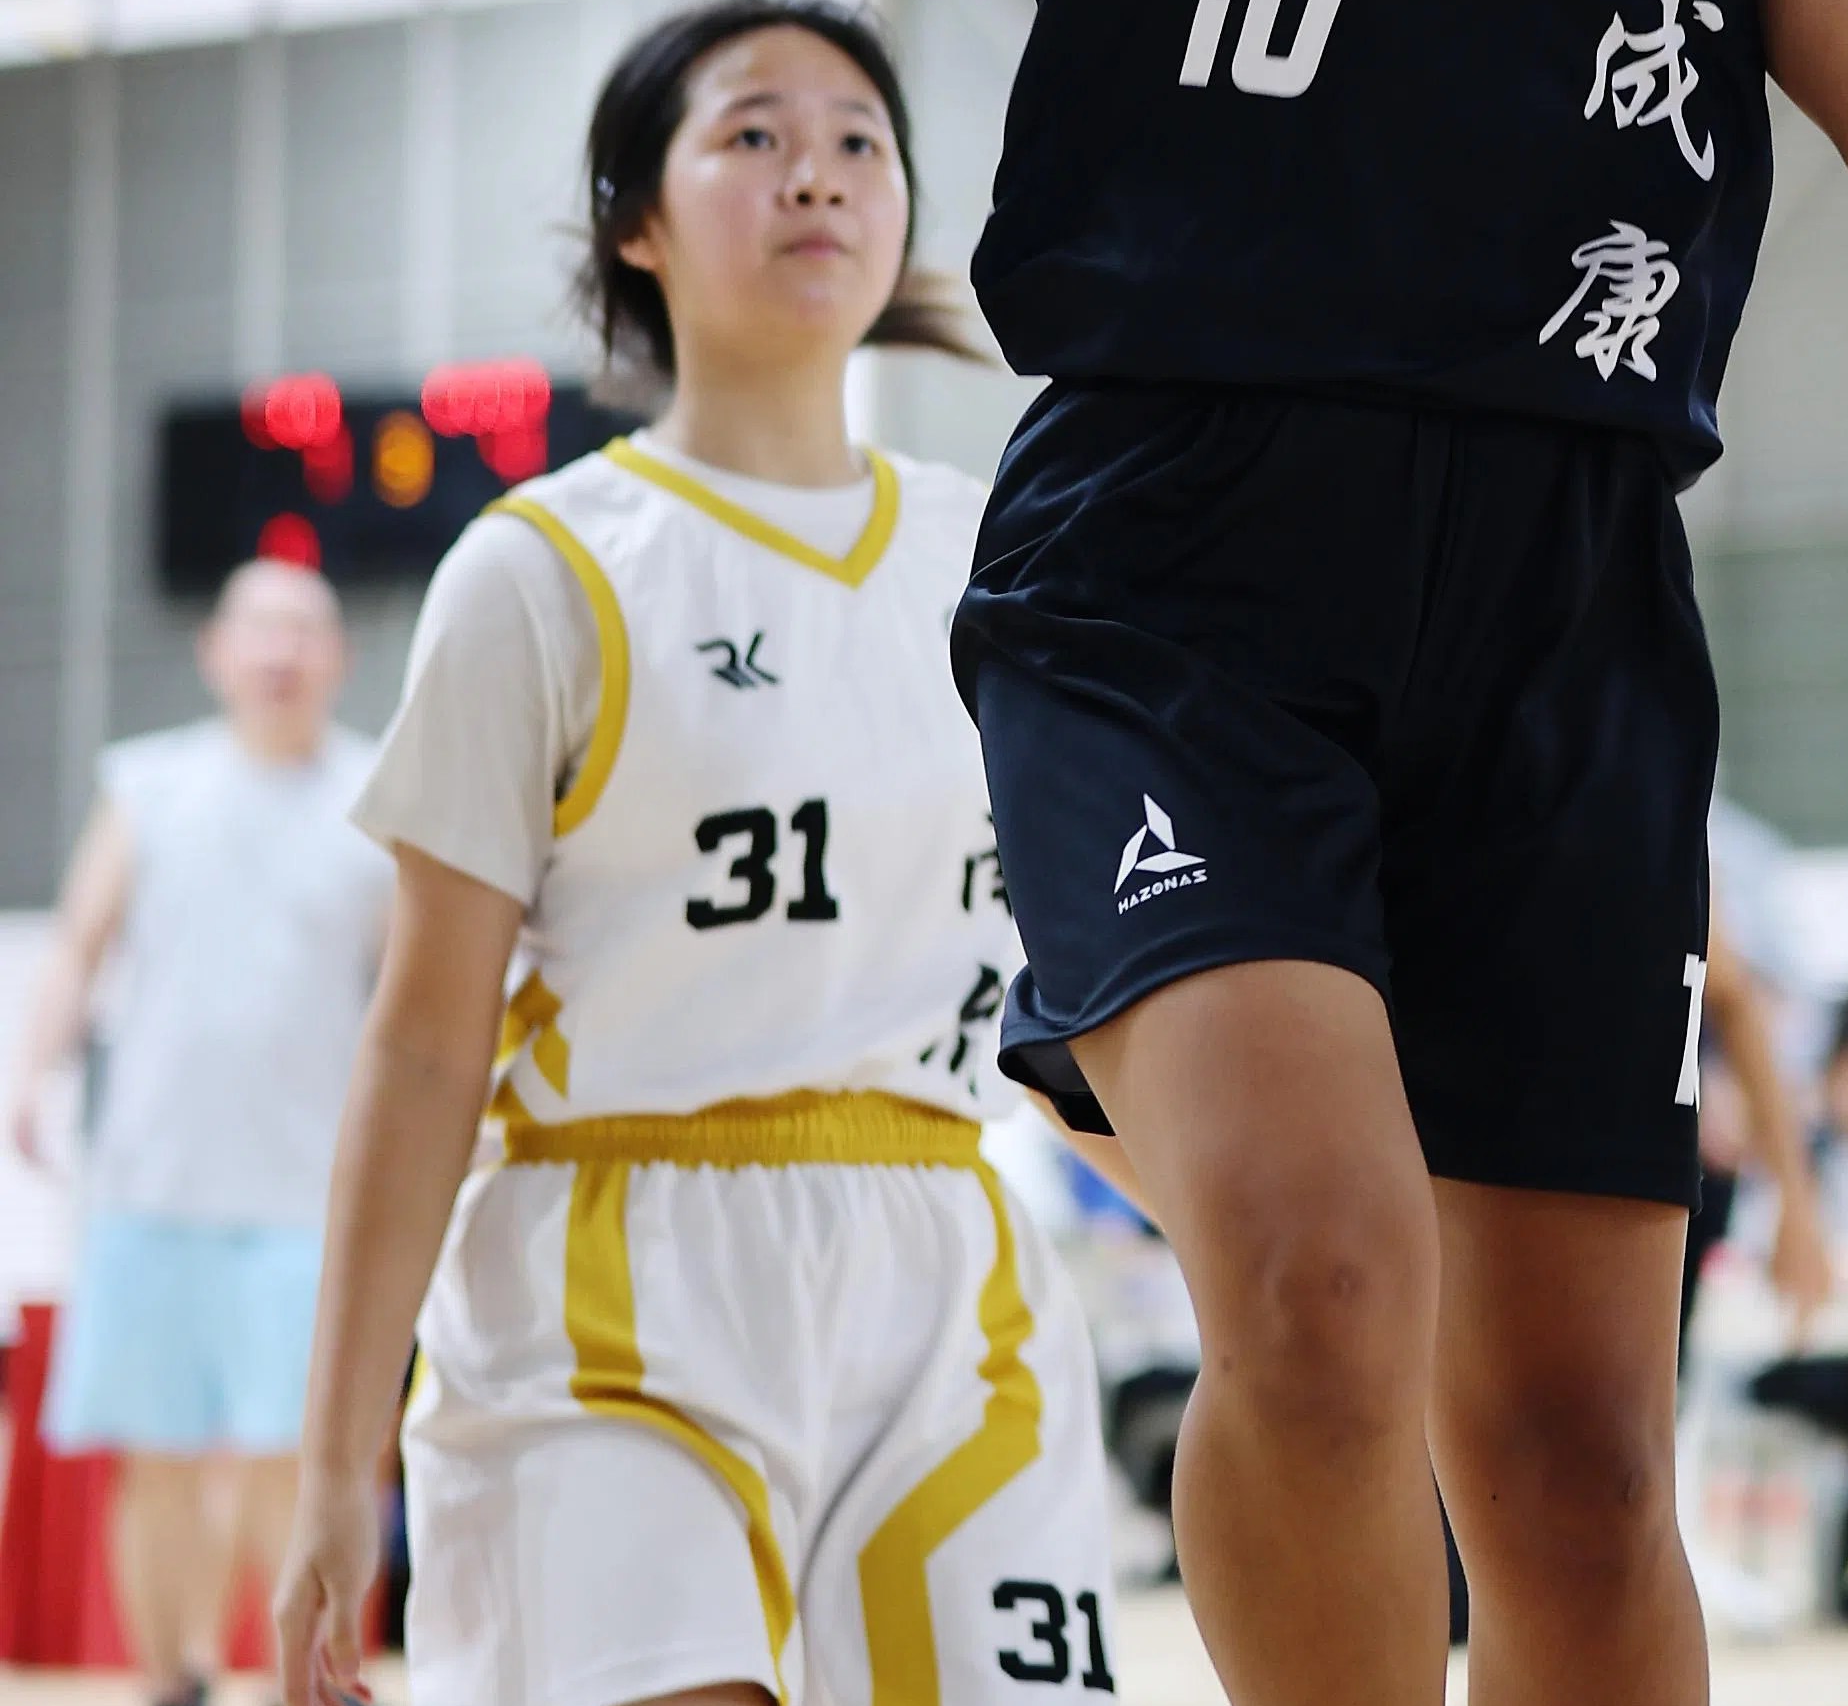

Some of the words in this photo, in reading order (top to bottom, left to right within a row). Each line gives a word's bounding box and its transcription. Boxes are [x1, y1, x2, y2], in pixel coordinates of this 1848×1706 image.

[686, 796, 839, 930] 31
[1117, 868, 1208, 915] HAZONAS
[992, 1579, 1115, 1694] 31
